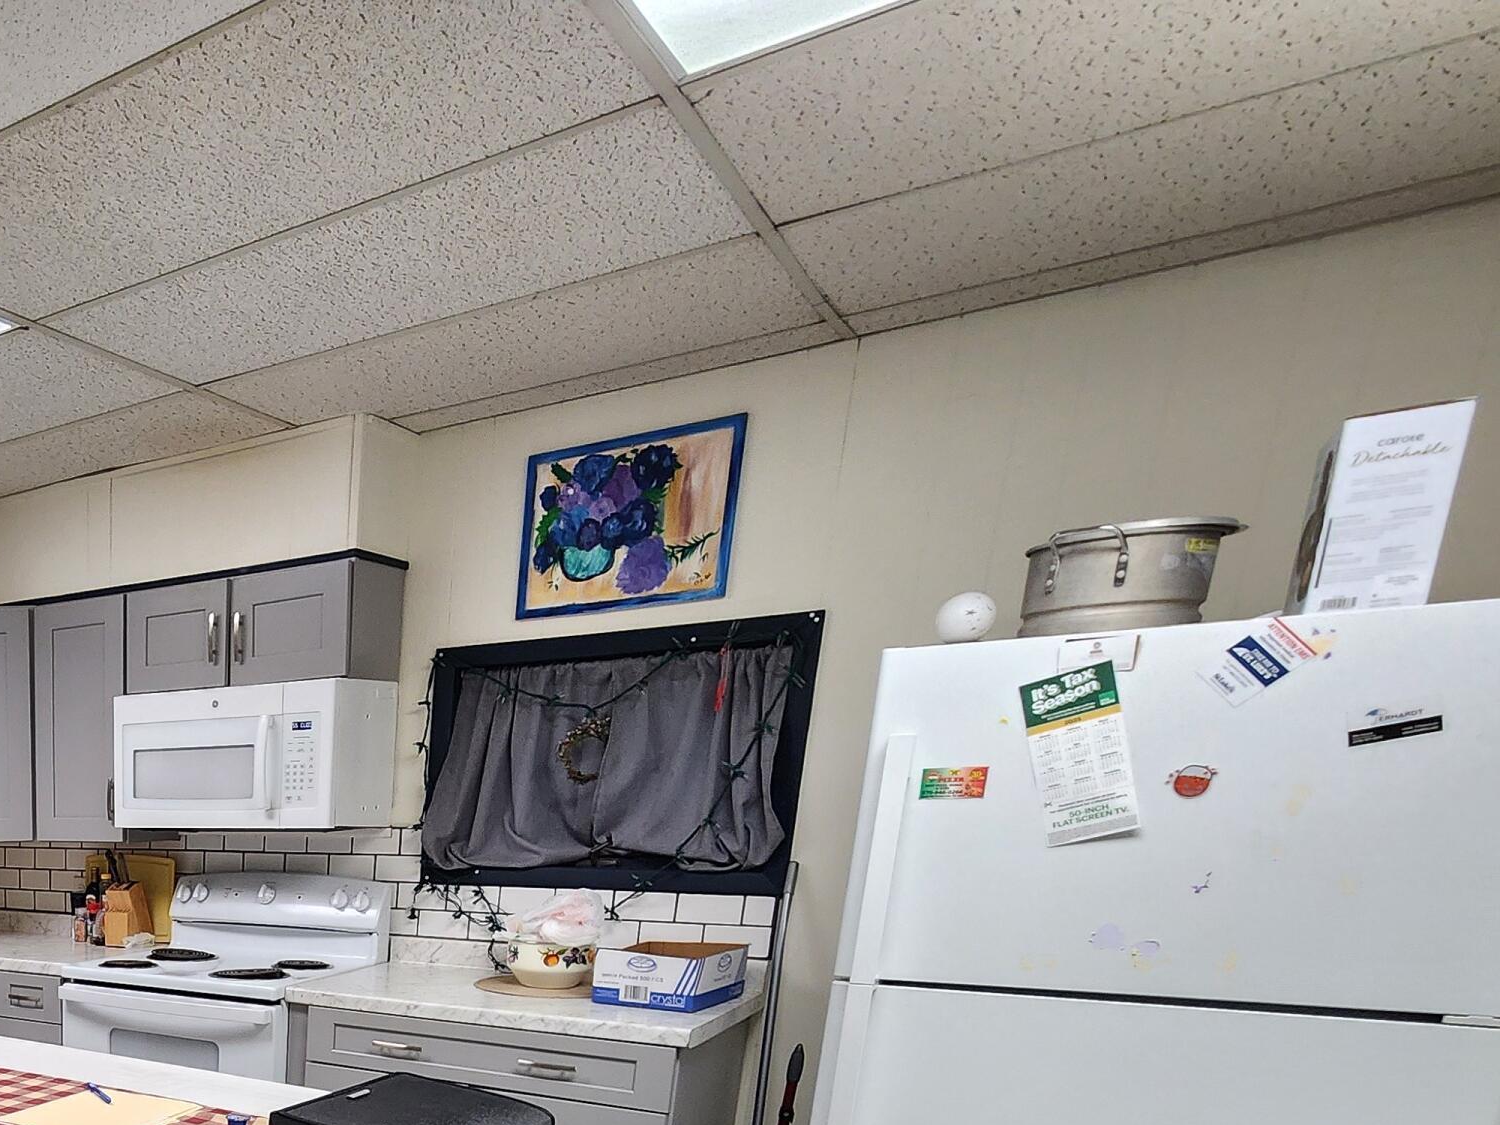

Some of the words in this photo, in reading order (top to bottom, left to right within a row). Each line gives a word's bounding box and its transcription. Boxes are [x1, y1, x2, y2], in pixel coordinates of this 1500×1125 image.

[1350, 441, 1452, 467] Detachable
[1031, 684, 1061, 702] It's
[1060, 668, 1097, 688] Tax
[1032, 680, 1101, 715] Season
[1076, 810, 1113, 823] SCREEN
[651, 992, 685, 1005] crystal
